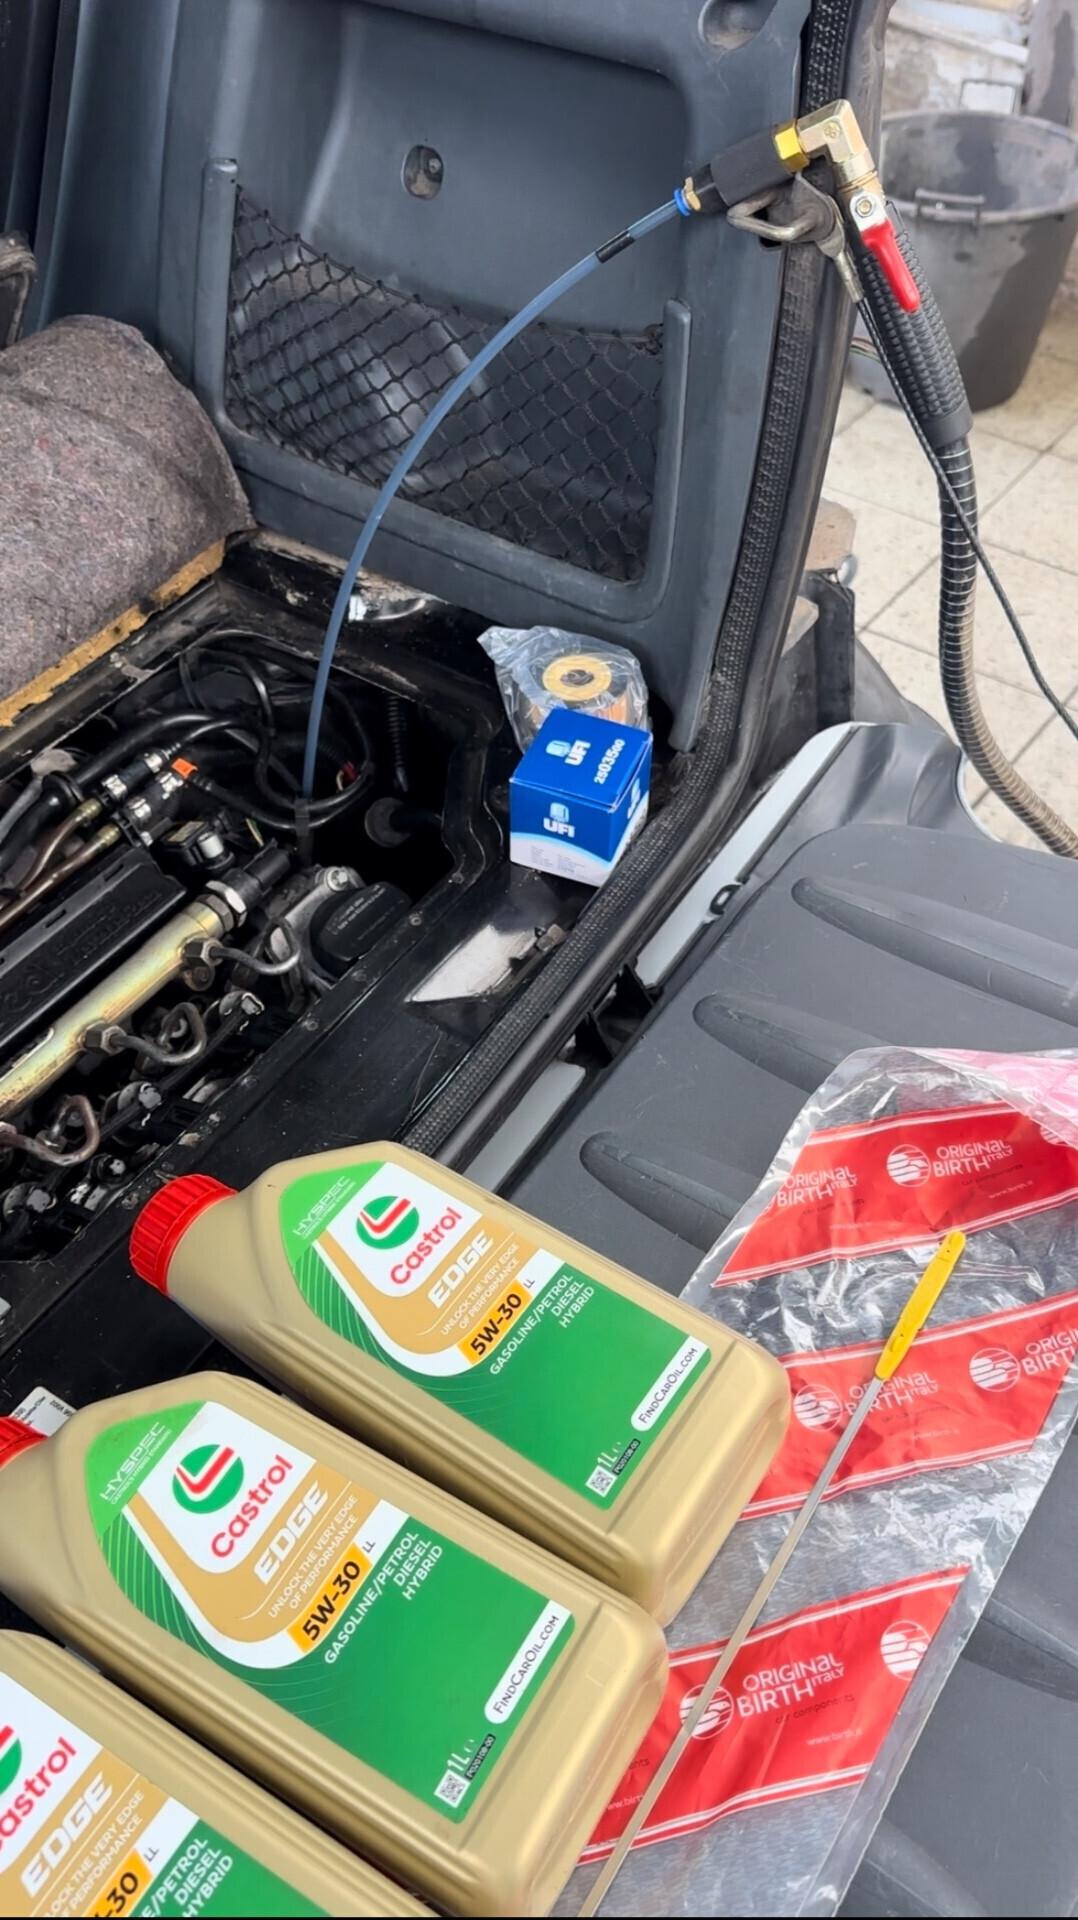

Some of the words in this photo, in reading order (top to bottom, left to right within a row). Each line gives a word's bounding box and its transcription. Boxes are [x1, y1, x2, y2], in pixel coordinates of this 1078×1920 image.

[564, 739, 591, 766] UFI
[543, 817, 575, 838] UFI
[293, 1176, 350, 1236] HYSPEC
[777, 1184, 833, 1207] BIRTH
[932, 1156, 990, 1178] BIRTH
[391, 1206, 463, 1285] Castrol
[427, 1230, 494, 1309] EDGE
[441, 1299, 472, 1336] UNLOCK
[468, 1283, 483, 1300] THE
[481, 1262, 501, 1284] VERY
[499, 1242, 520, 1265] EDGE
[459, 1314, 471, 1329] OF
[468, 1257, 519, 1317] PERFORMANCE
[470, 1293, 522, 1356] 5W-30
[523, 1278, 536, 1290] LL
[490, 1274, 574, 1376] GASOLINE/PETROL
[550, 1280, 585, 1318] DIESEL
[558, 1287, 595, 1329] HYBRID
[99, 1422, 166, 1501] HYSPEC
[211, 1454, 293, 1558] Castrol
[254, 1480, 328, 1585] EDGE
[268, 1572, 304, 1618] UNLOCK
[299, 1549, 318, 1573] THE
[314, 1522, 337, 1551] VERY
[335, 1494, 359, 1522] EDGE
[289, 1591, 303, 1609] OF
[300, 1514, 358, 1594] PERFORMANCE
[303, 1560, 360, 1641] 5W-30
[362, 1539, 376, 1554] LL
[393, 1540, 432, 1587] DIESEL
[402, 1545, 443, 1600] HYBRID
[324, 1531, 419, 1664] GASOLINE/PETROL
[736, 1678, 815, 1718] BIRTH
[0, 1736, 77, 1851] astrol
[20, 1771, 113, 1898] EDGE
[69, 1816, 143, 1911] PERFORMANCE
[70, 1856, 94, 1883] THE
[90, 1823, 118, 1857] VERY
[117, 1790, 145, 1826] EDGE
[144, 1847, 159, 1863] LL
[174, 1848, 222, 1907] DIESEL
[182, 1855, 233, 1917] HYBRID
